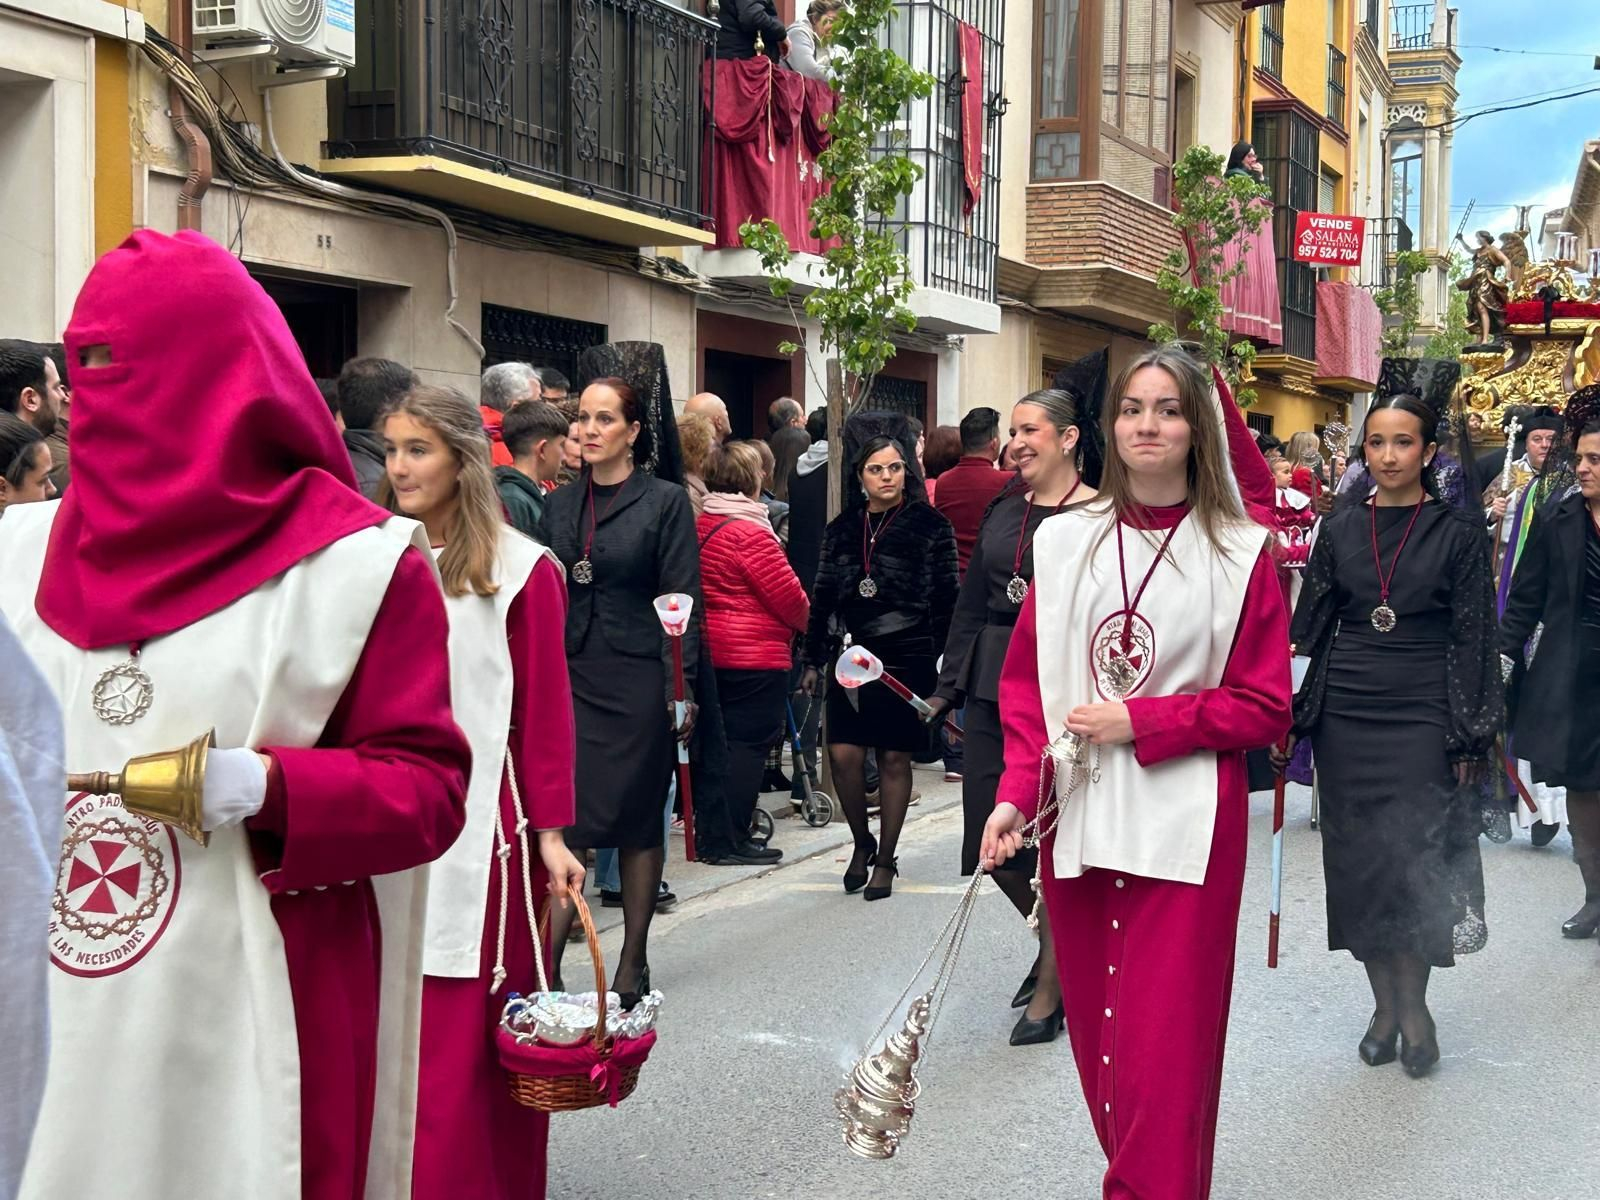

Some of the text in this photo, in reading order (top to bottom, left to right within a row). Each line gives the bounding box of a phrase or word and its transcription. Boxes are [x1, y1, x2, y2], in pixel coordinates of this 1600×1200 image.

[1310, 218, 1353, 230] VENDE
[1315, 230, 1359, 244] SALANA
[1298, 245, 1358, 261] 957 524 704
[66, 802, 95, 829] NTRO
[99, 796, 124, 809] PAD
[53, 937, 74, 956] LAS
[75, 929, 146, 966] NECESIDADES
